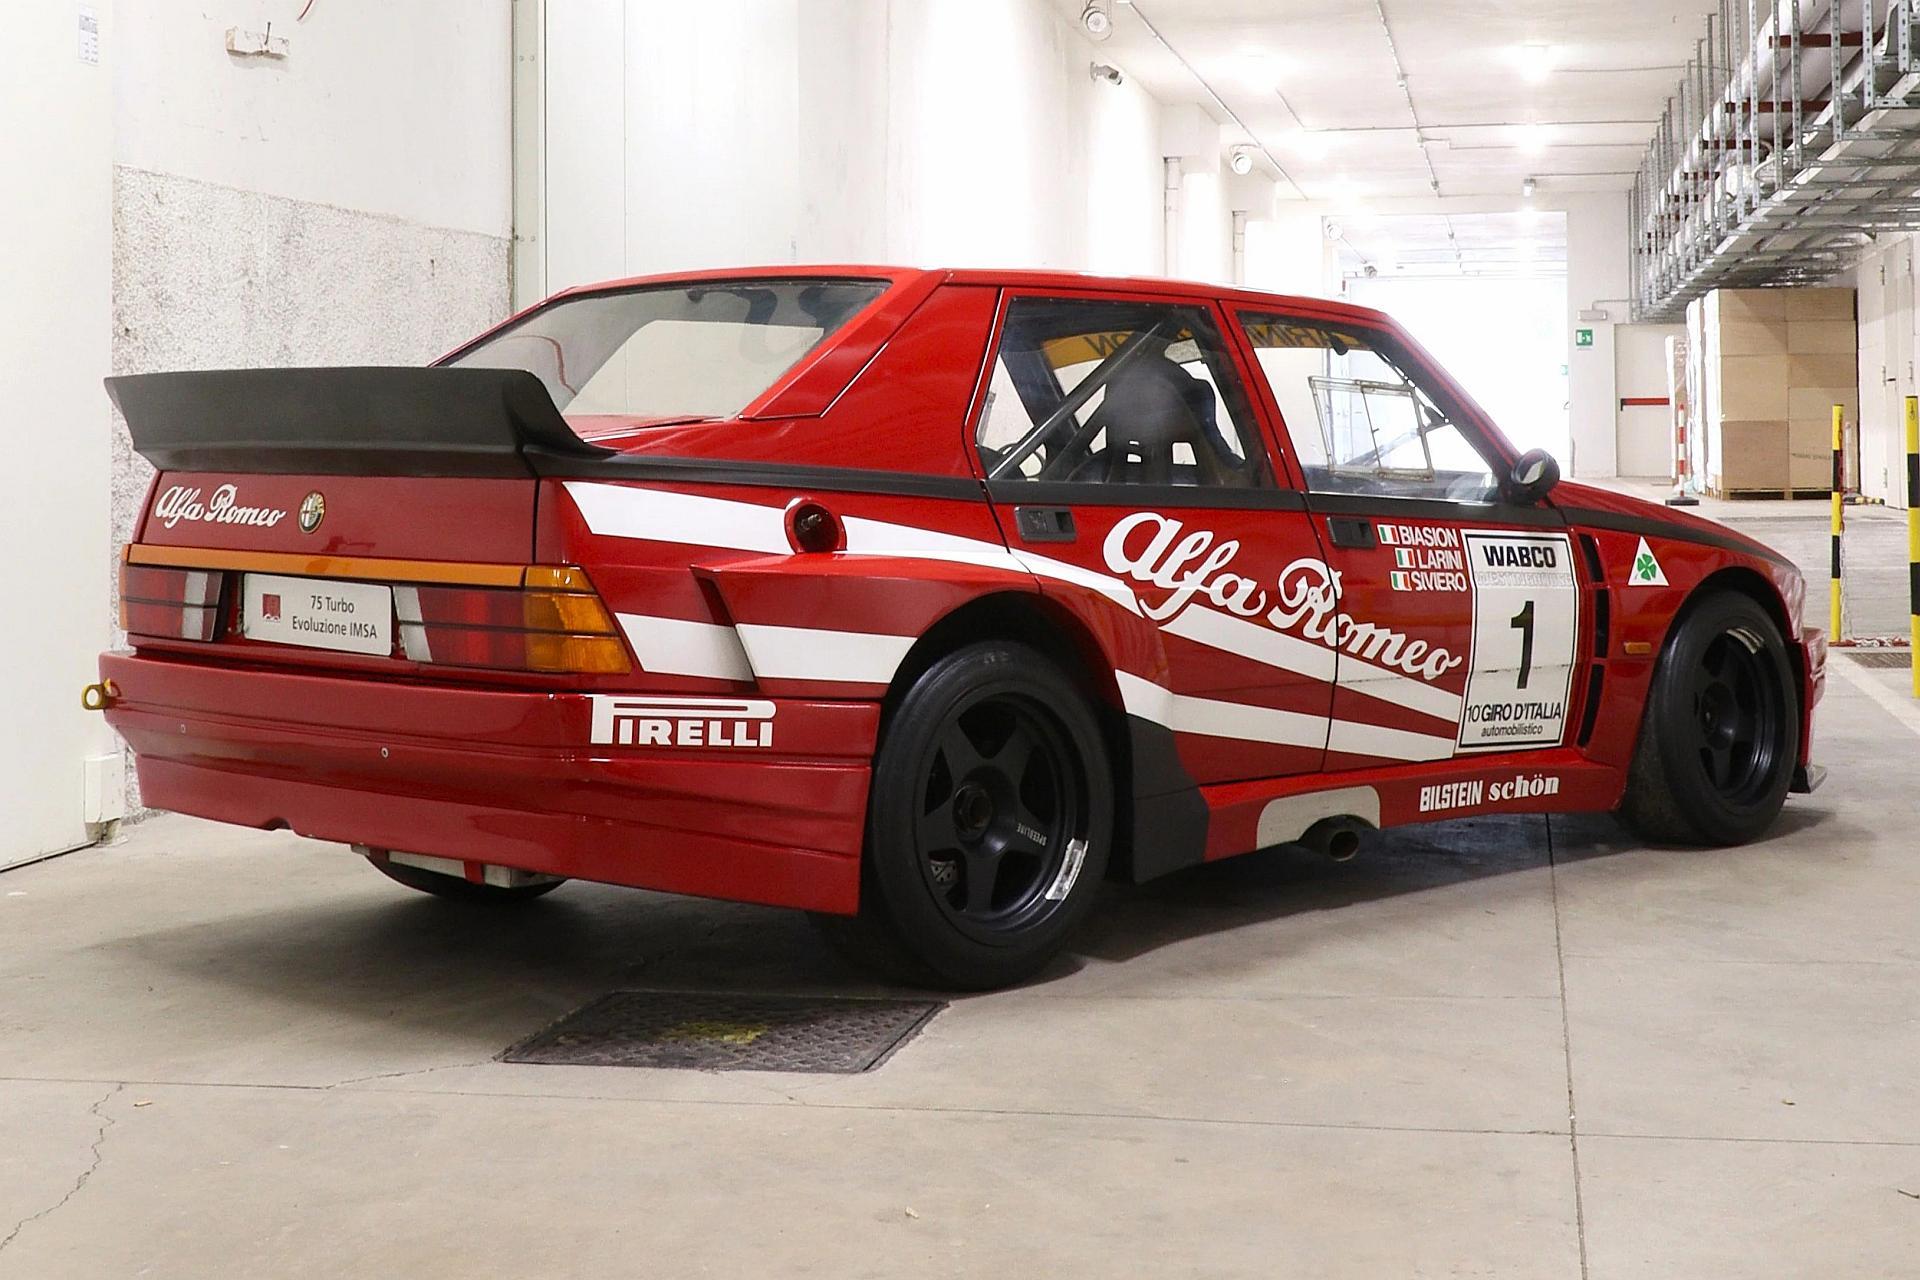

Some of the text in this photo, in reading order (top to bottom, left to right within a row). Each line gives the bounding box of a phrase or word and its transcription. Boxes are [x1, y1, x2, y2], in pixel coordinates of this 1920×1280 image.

[155, 486, 205, 528] Alfa
[204, 483, 286, 527] Romeo
[1398, 526, 1459, 547] BIASION
[1417, 550, 1463, 570] LARINI
[1482, 545, 1556, 568] WABCO
[1411, 571, 1467, 592] SIVIERO
[310, 595, 354, 613] 75 Turbo
[1102, 512, 1462, 680] Alfa Romeo
[292, 616, 378, 639] Evoluzione IMSA
[1510, 600, 1534, 689] 1
[590, 694, 777, 747] PIRELLI
[1481, 703, 1512, 722] GIRO
[1514, 702, 1562, 720] D'ITALIA
[1481, 723, 1543, 737] automobilistico
[1419, 773, 1559, 812] BILSTEIN schön
